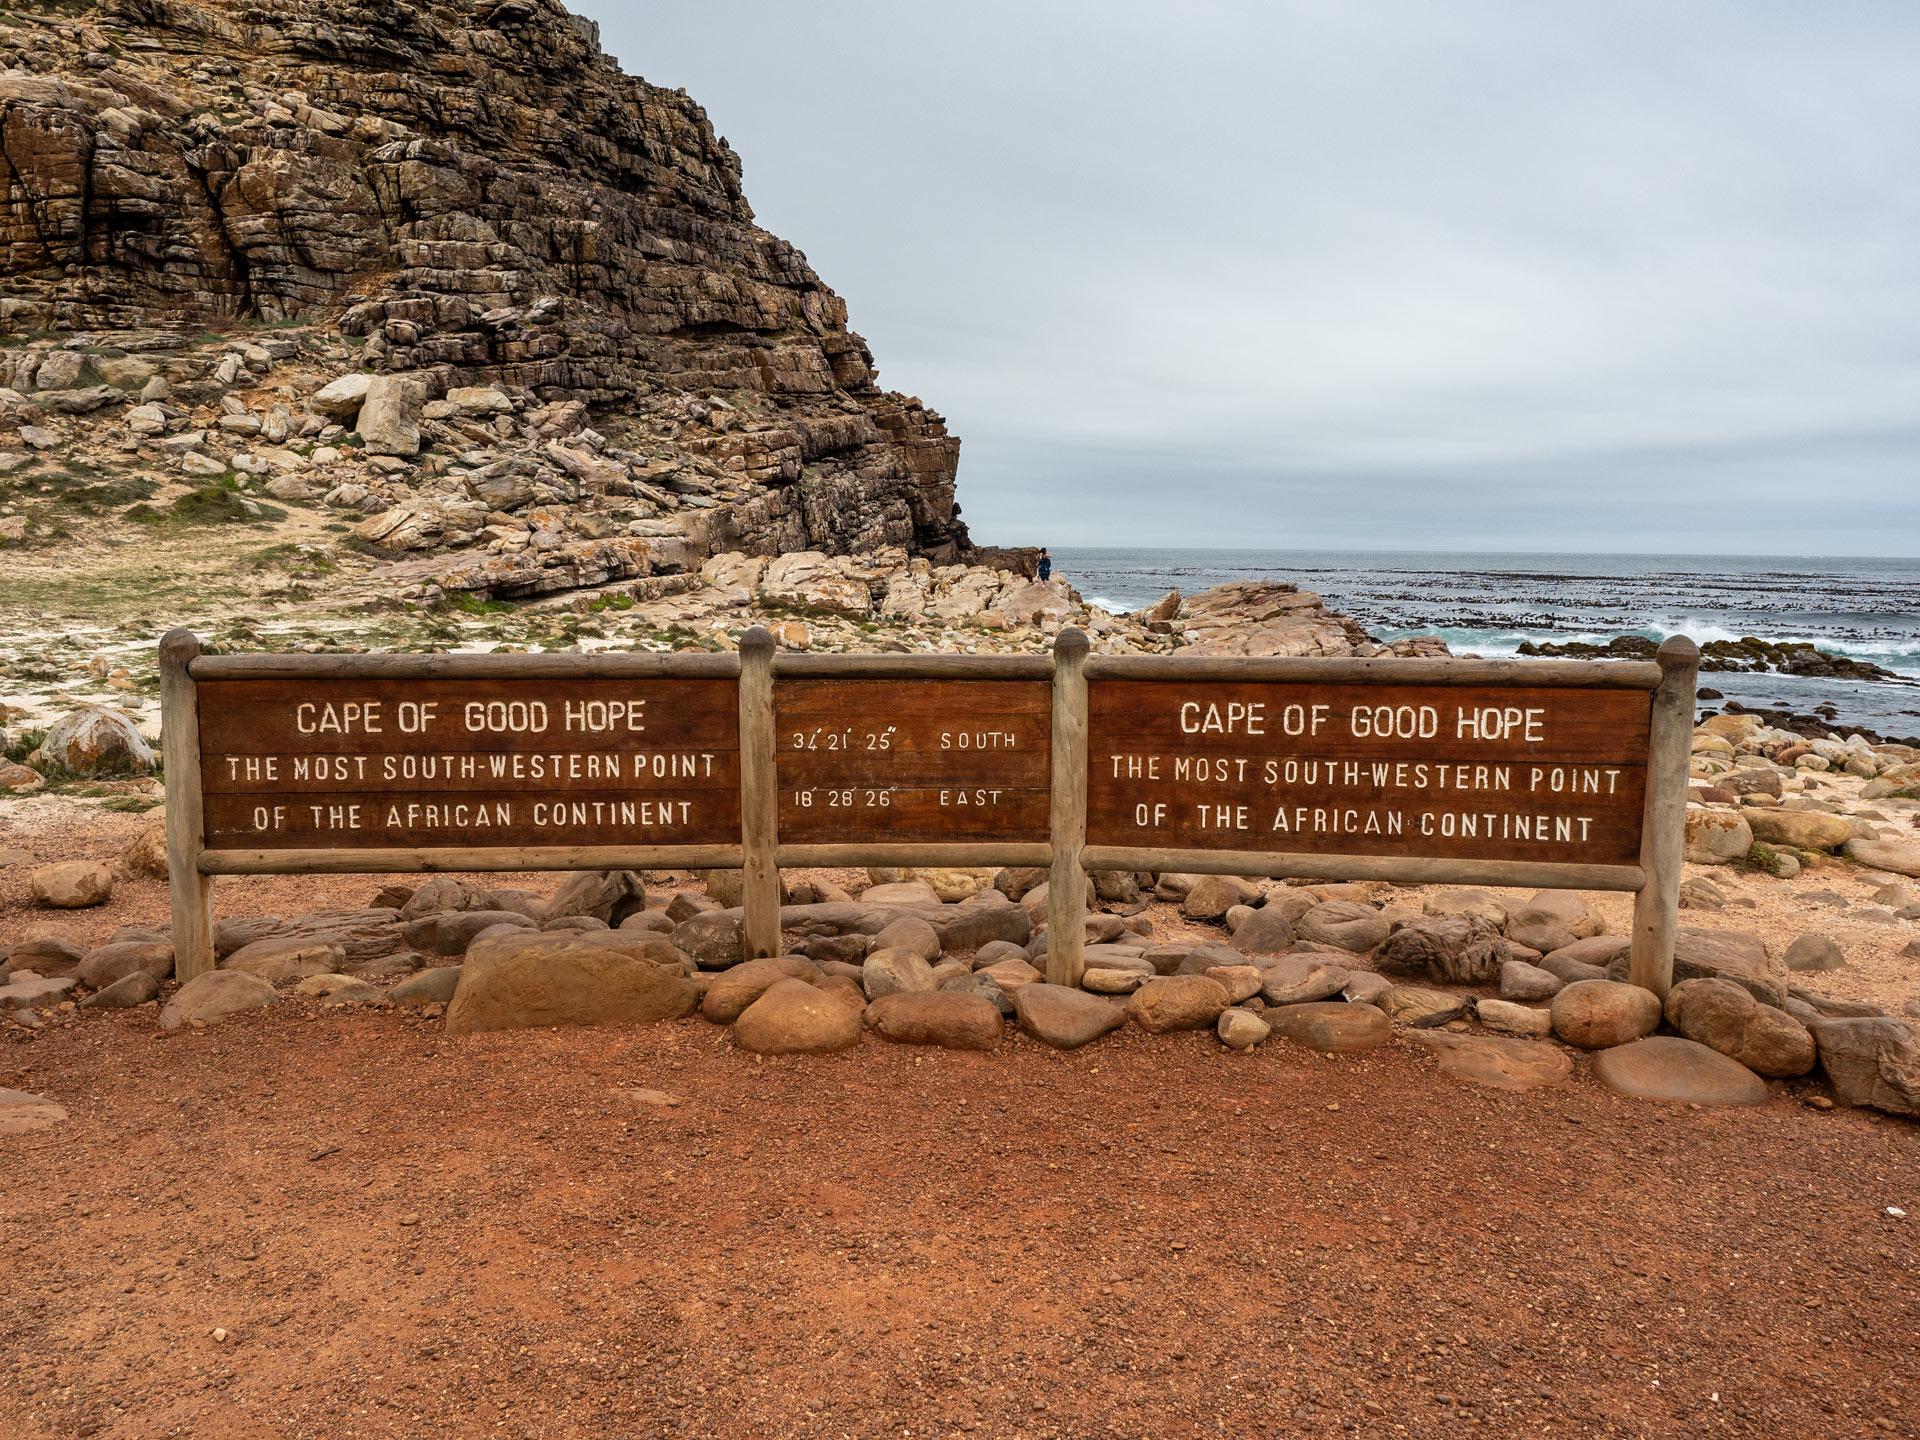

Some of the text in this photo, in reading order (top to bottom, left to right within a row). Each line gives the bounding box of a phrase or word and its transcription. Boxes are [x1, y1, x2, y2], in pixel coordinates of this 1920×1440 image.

[297, 700, 646, 734] CAPE OF GOOD HOPE
[1180, 702, 1546, 742] CAPE OF GOOD HOPE
[941, 732, 1015, 749] SOUTH
[226, 754, 715, 780] THE MOST SOUTH-WESTERN POINT
[1111, 755, 1621, 794] THE MOST SOUTH-WESTERN POINT
[940, 790, 1002, 806] EAST
[254, 802, 692, 830] OF THE AFRICAN CONTINENT
[1136, 803, 1593, 842] OF THE AFRICAN CONTINENT
